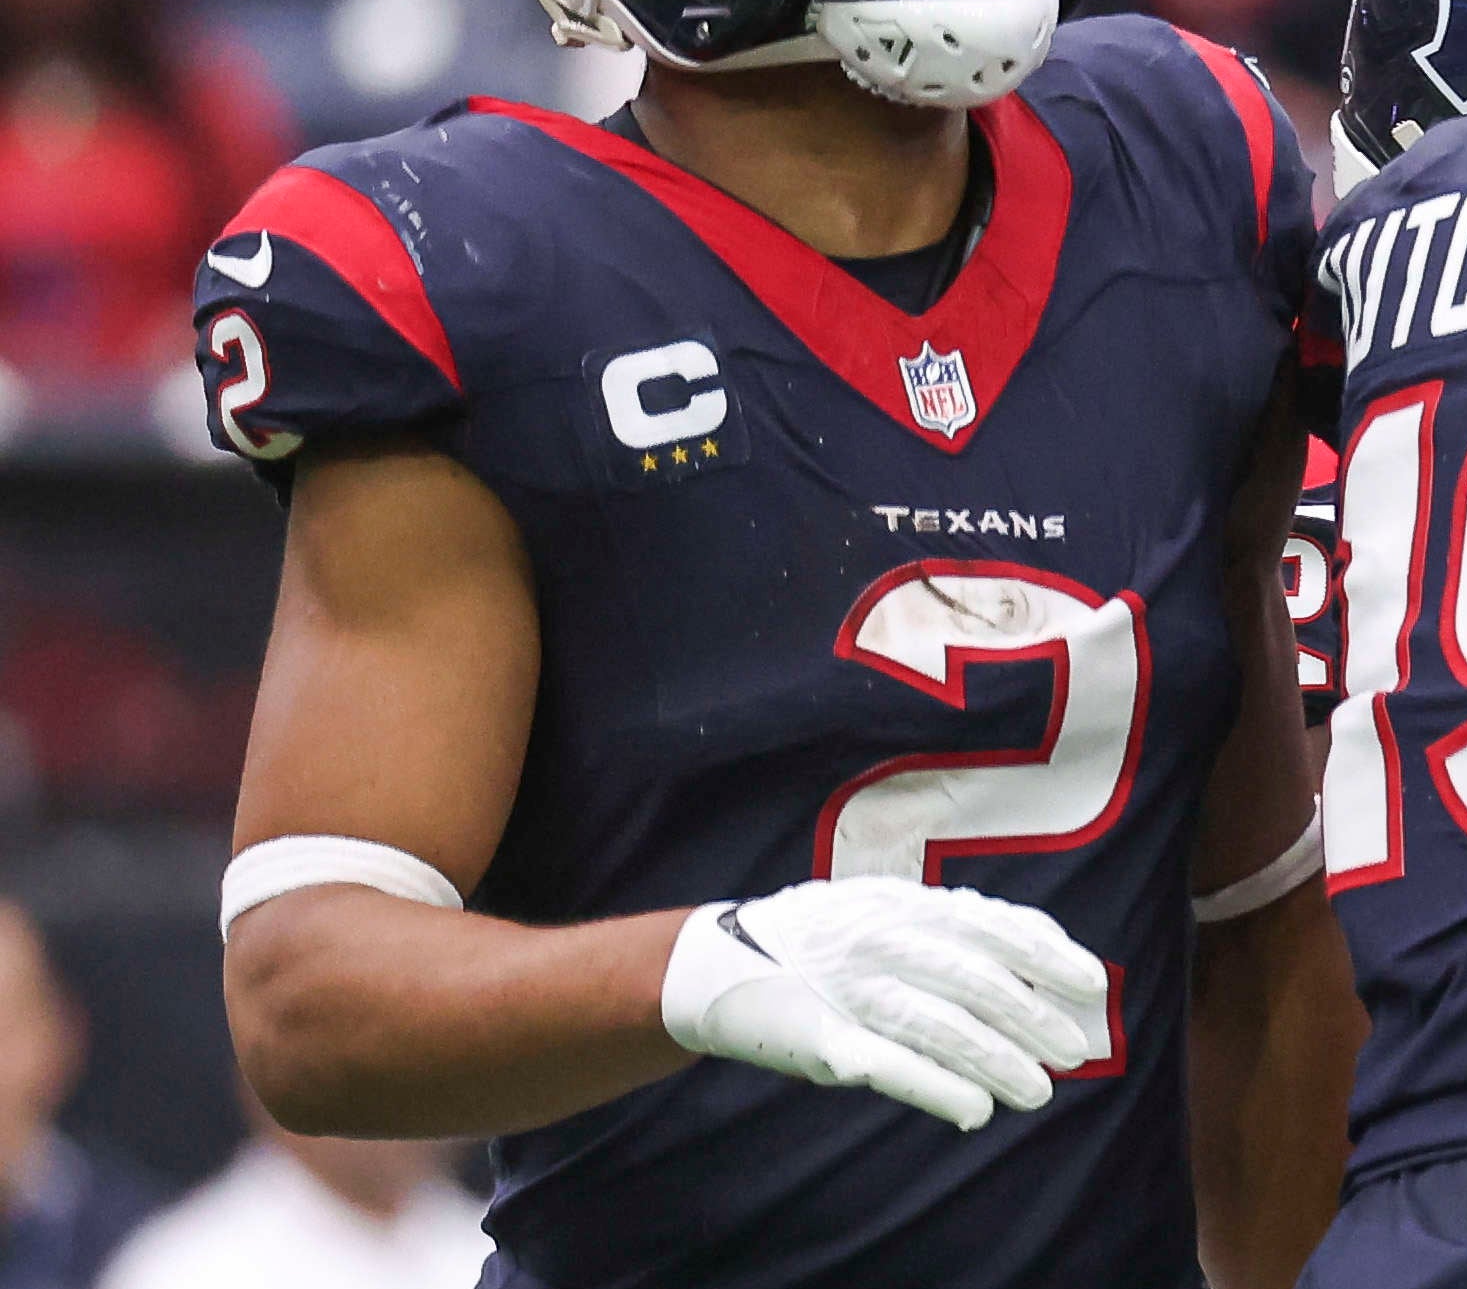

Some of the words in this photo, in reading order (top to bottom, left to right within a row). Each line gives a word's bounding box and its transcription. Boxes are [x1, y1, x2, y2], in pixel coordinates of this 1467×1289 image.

[207, 307, 306, 461] 2
[601, 339, 727, 450] C
[919, 385, 965, 418] NFL
[871, 504, 1065, 542] TEXANS
